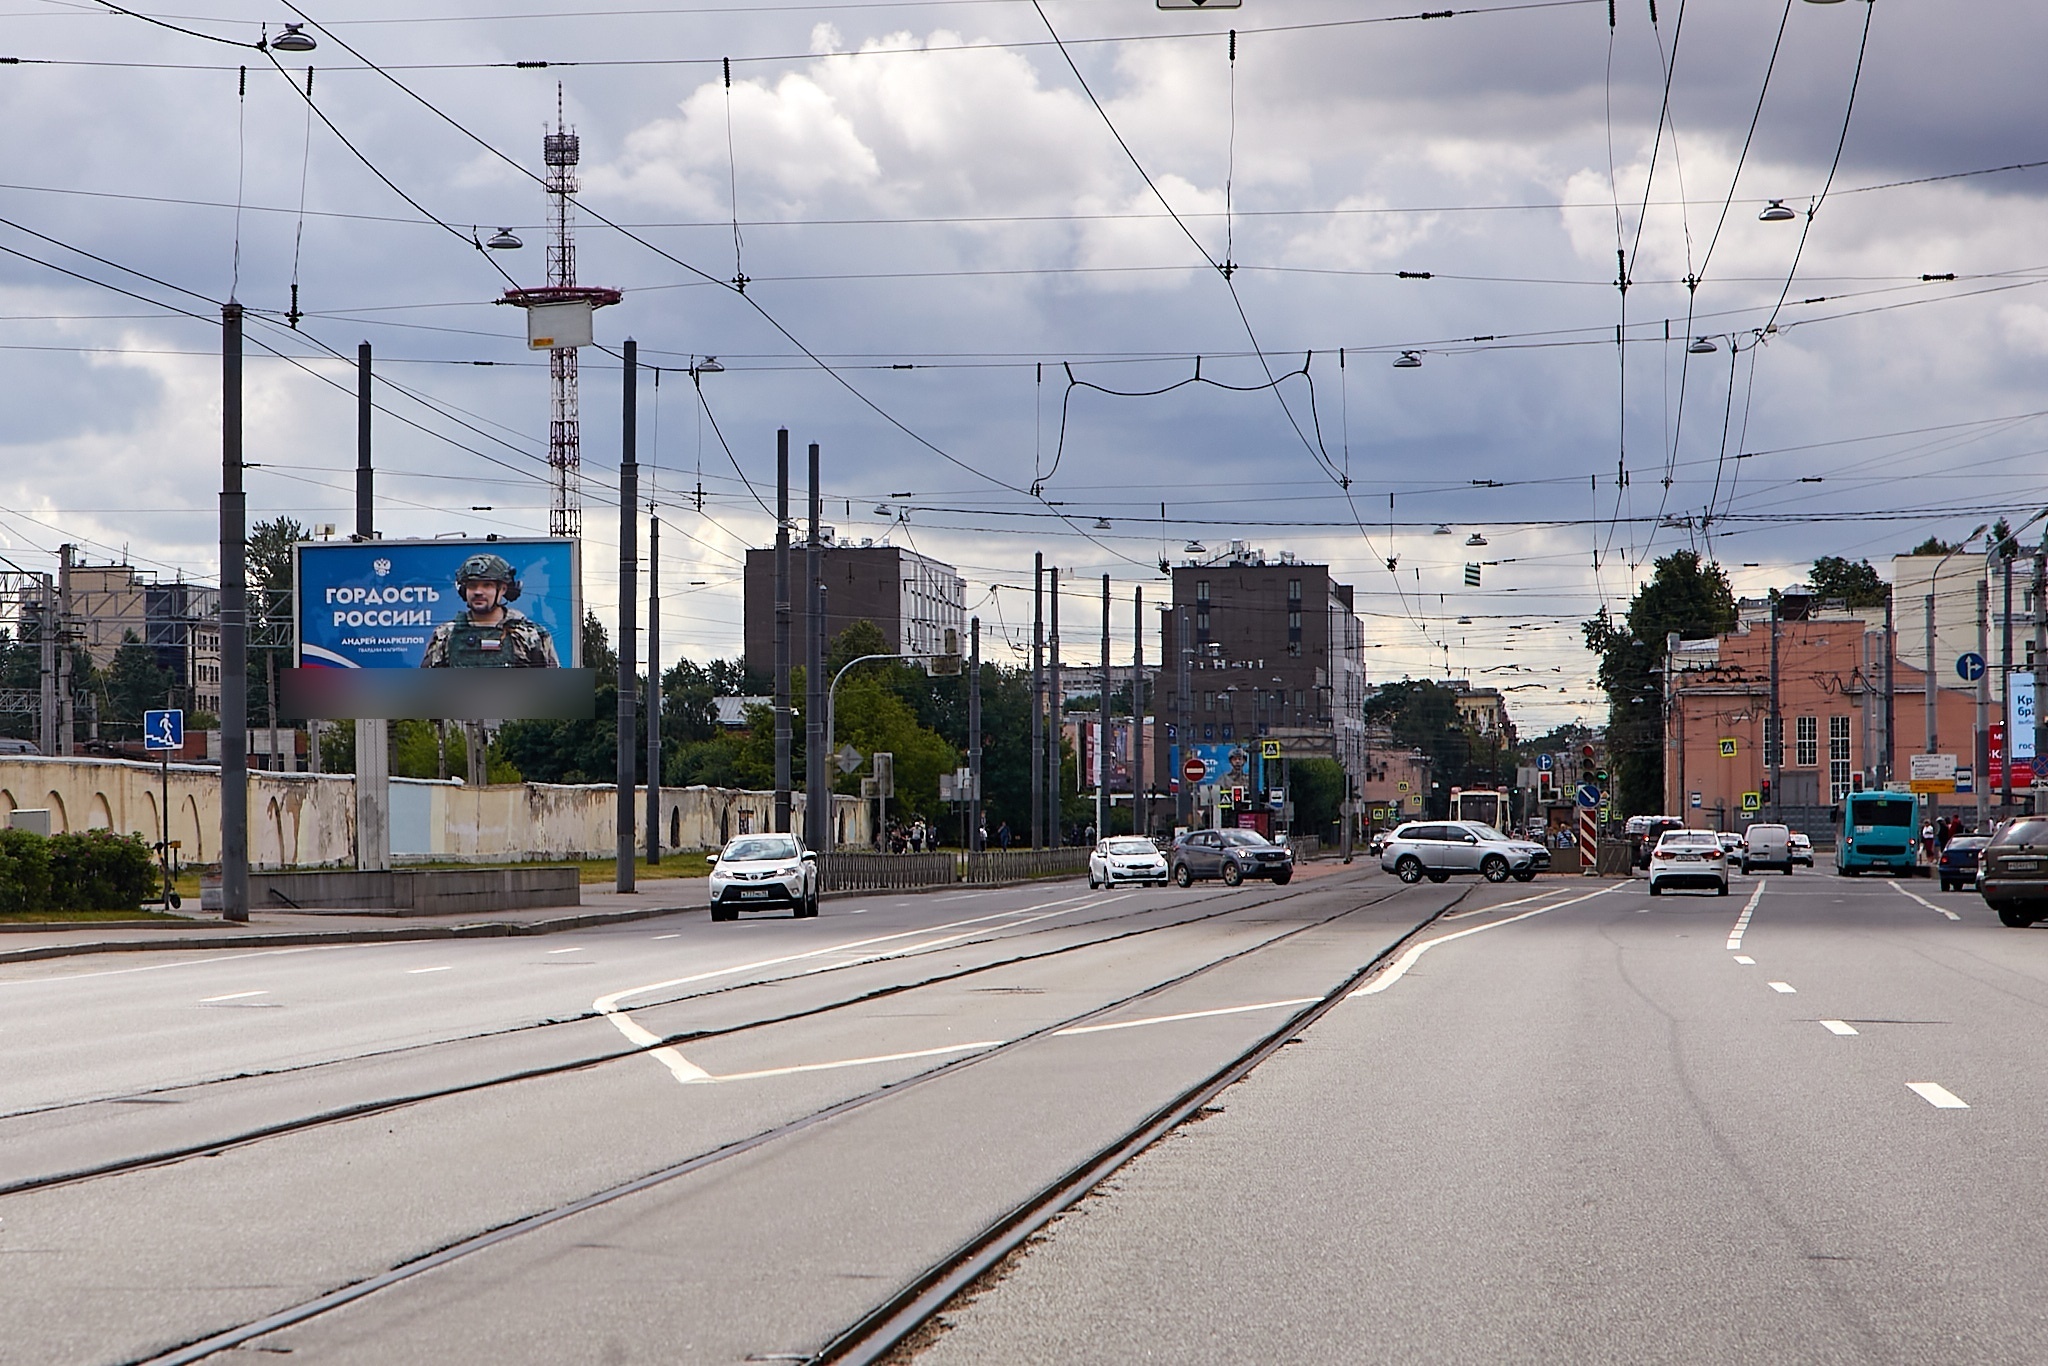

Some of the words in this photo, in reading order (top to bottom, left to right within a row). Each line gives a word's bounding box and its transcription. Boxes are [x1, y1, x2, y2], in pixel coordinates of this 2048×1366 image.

[326, 587, 440, 605] ГОРДОСТЬ
[333, 610, 432, 627] РОССИИ!
[341, 637, 376, 646] АНДРЕЙ
[378, 636, 425, 645] МАРКЕЛОВ
[2017, 695, 2035, 706] Кр
